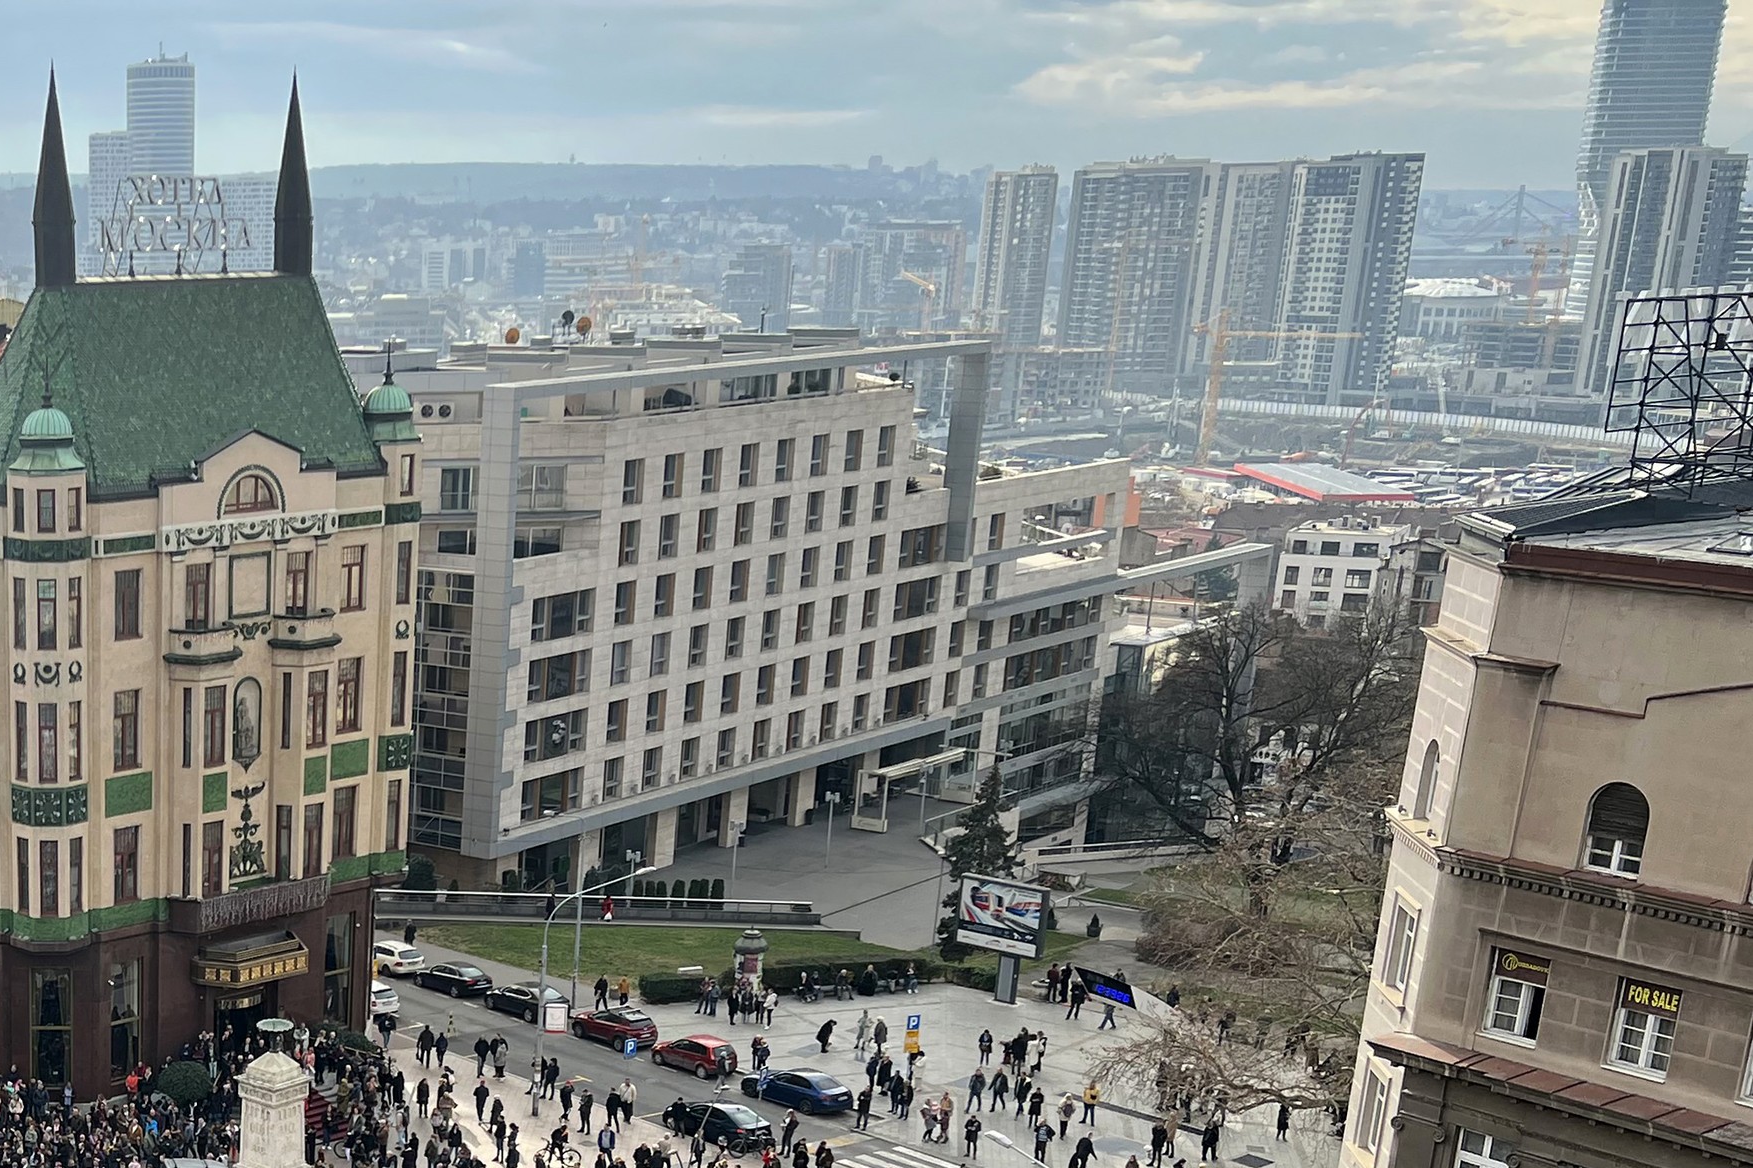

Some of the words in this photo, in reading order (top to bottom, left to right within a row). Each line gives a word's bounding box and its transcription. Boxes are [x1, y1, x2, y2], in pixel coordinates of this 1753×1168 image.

[98, 217, 254, 251] МОСКВА
[1628, 985, 1650, 1005] FOR
[1651, 990, 1680, 1012] SALE
[909, 1017, 918, 1029] P
[627, 1041, 636, 1054] P
